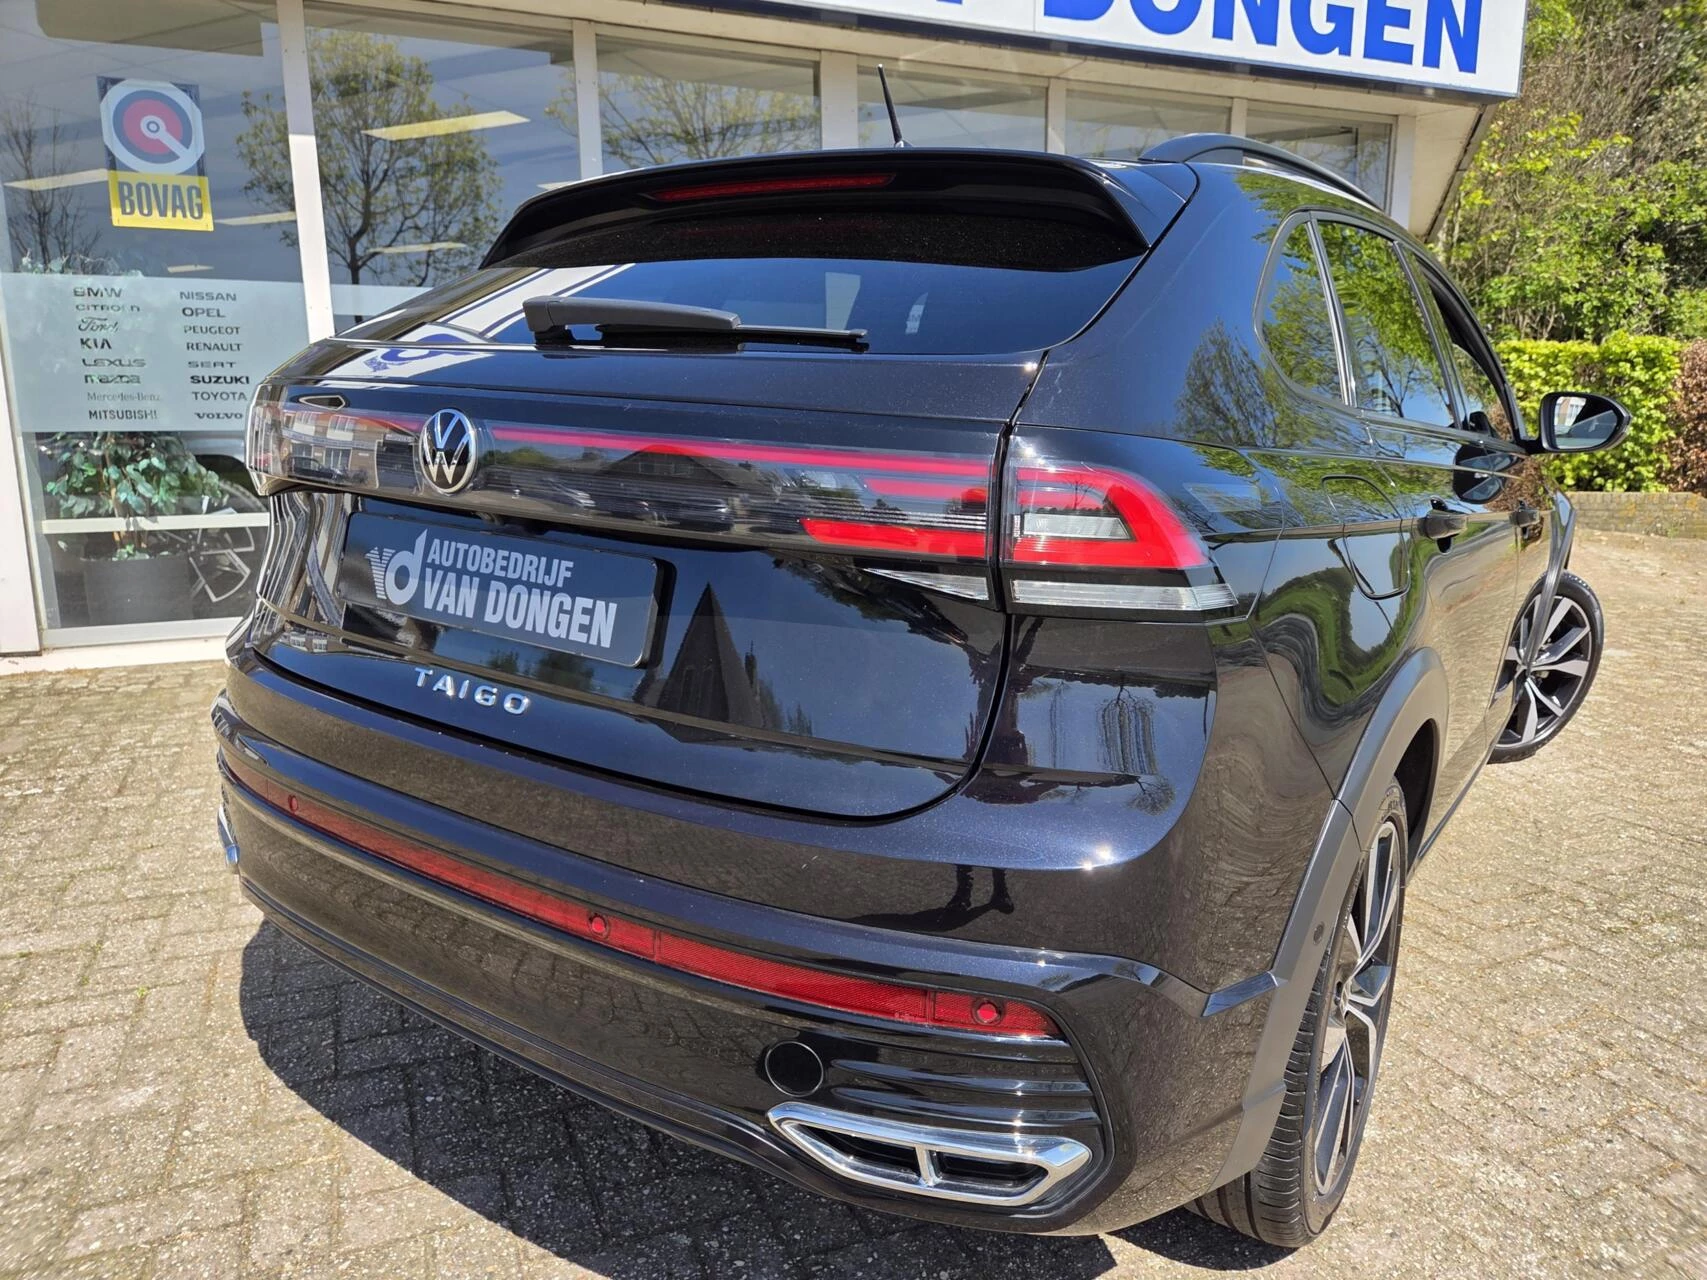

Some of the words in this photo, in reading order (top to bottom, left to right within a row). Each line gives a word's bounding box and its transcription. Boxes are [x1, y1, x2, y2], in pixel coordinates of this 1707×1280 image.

[118, 181, 204, 219] BOVAG
[73, 287, 122, 298] BMW
[180, 291, 237, 301] NISSAN
[182, 307, 226, 318] OPEL
[78, 316, 120, 332] Ford
[183, 325, 240, 335] PEUGEOT
[80, 338, 112, 350] KIA
[186, 342, 243, 352] RENAULT
[82, 358, 146, 367] LEXUS
[190, 375, 250, 385] SUZUKI
[192, 391, 248, 401] TOYOTA
[88, 409, 158, 420] MITSUBISHI
[194, 412, 243, 420] VOLVO
[427, 538, 574, 588] AUTOBEDRIJF
[424, 568, 480, 619] VAN
[484, 580, 617, 648] DONGEN
[415, 667, 530, 716] TAIGO
